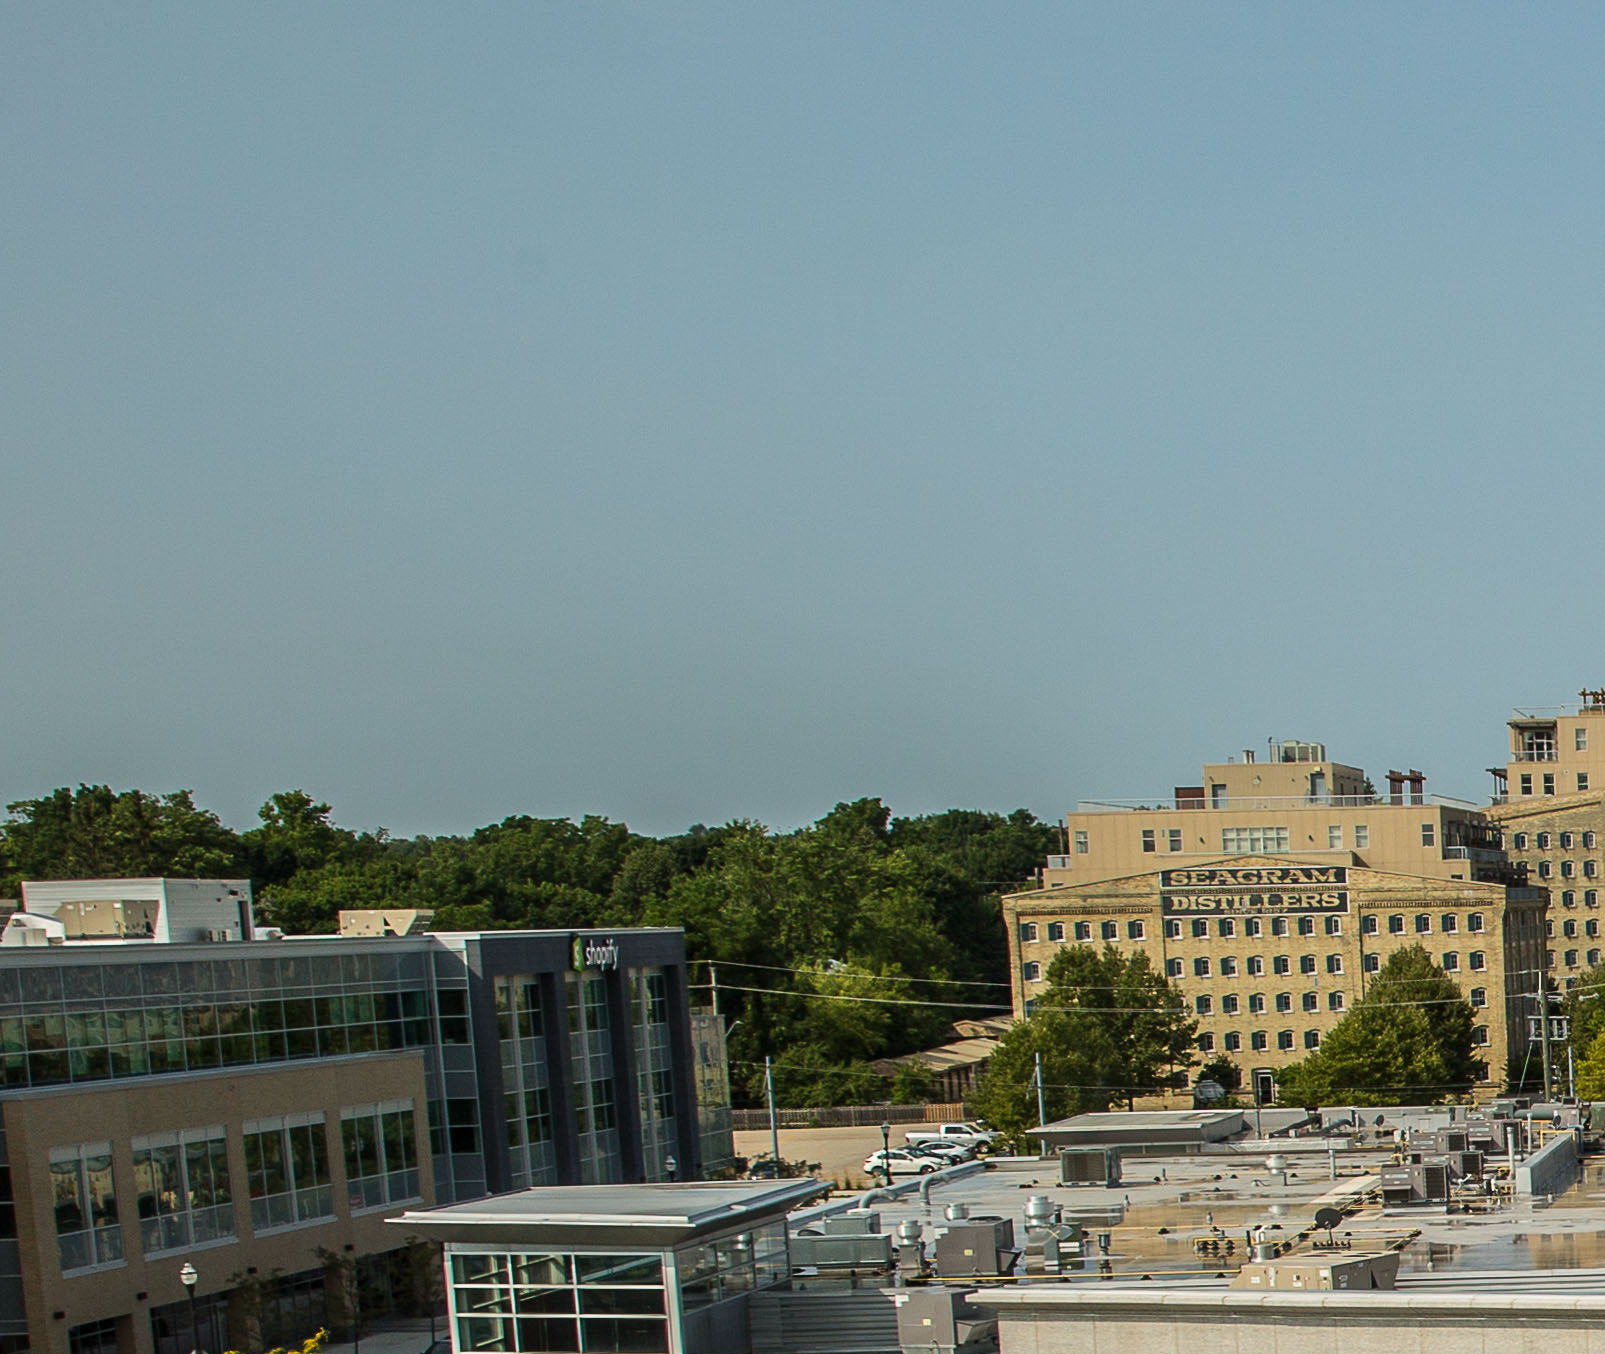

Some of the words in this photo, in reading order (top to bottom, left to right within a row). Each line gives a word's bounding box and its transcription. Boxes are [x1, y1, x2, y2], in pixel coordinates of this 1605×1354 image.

[1169, 868, 1337, 886] SEAGRAM
[1170, 893, 1341, 911] DISTILLERS
[585, 938, 619, 971] shopify
